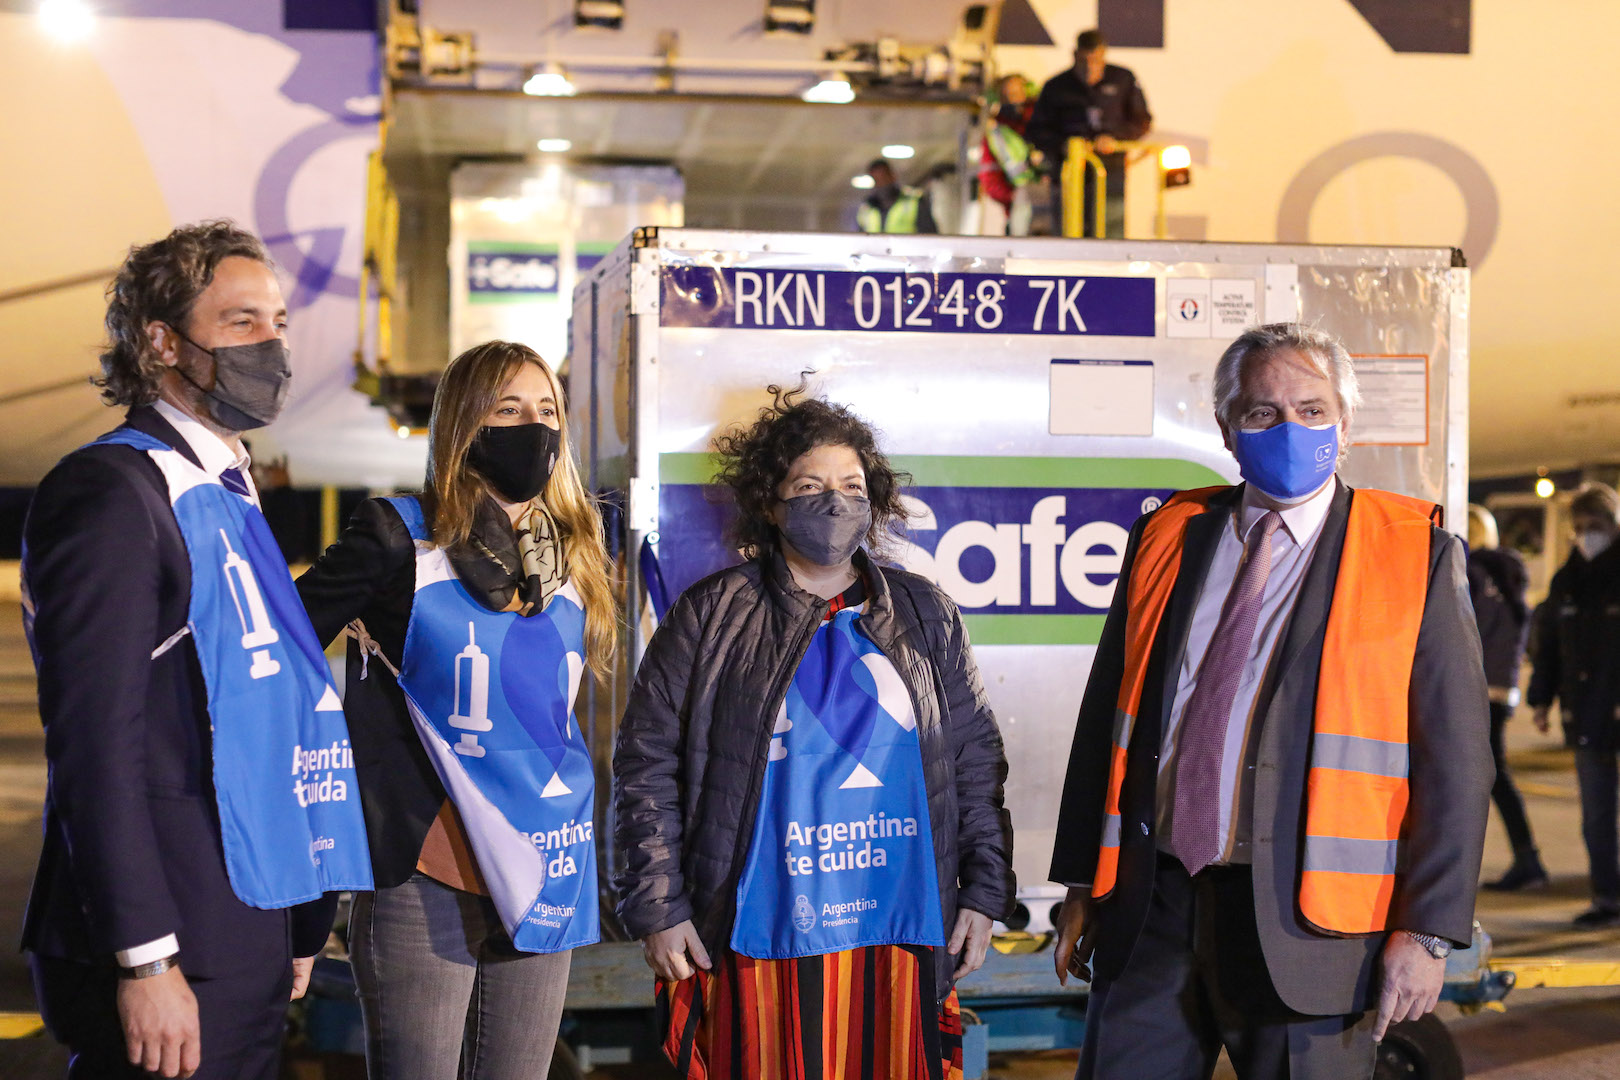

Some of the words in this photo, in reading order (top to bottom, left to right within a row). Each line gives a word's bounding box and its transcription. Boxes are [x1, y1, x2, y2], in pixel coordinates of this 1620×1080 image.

[734, 272, 826, 328] RKN
[853, 275, 1004, 329] 01248
[1028, 279, 1088, 333] 7K
[521, 819, 593, 850] entina
[784, 811, 918, 851] Argentina
[785, 851, 813, 876] te
[818, 841, 887, 873] cuida
[822, 898, 878, 917] Argentina
[822, 916, 859, 928] Presidencia
